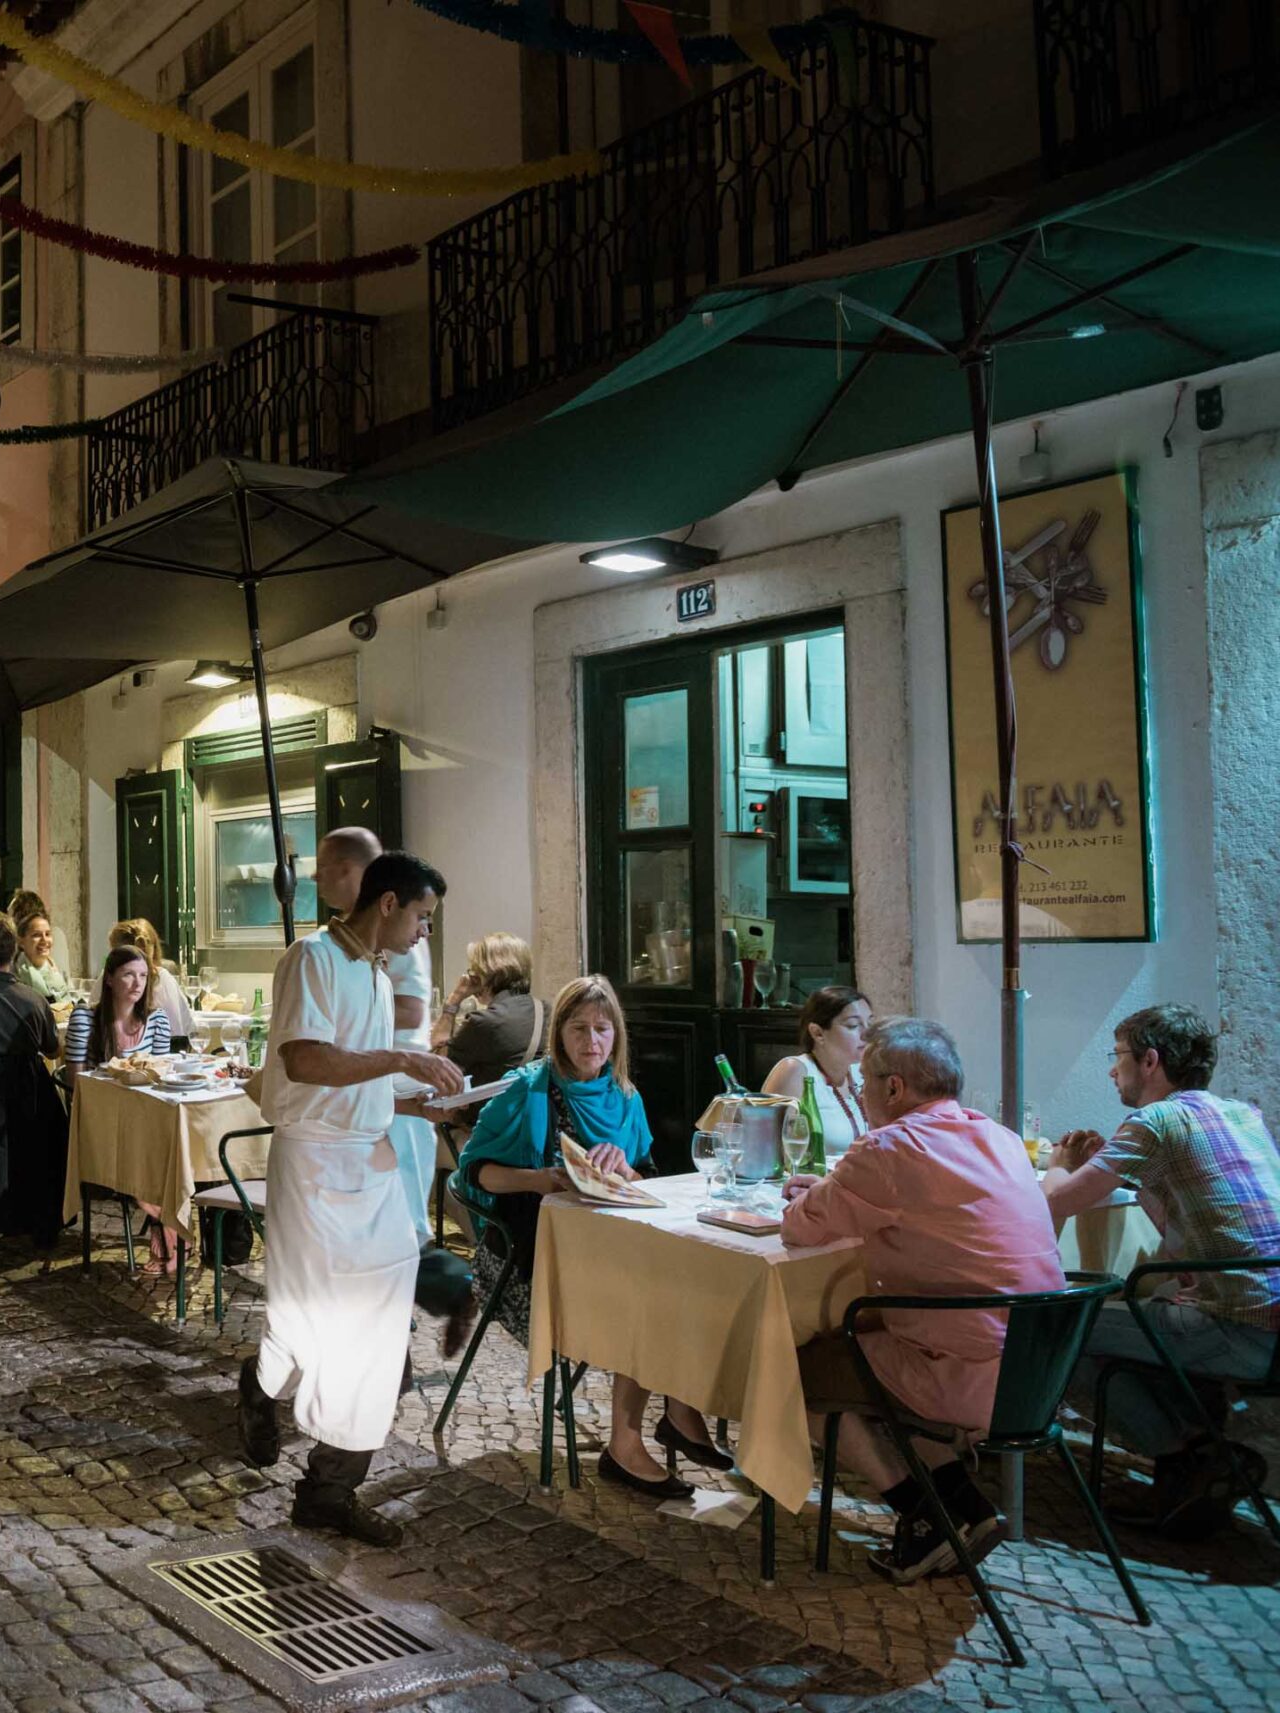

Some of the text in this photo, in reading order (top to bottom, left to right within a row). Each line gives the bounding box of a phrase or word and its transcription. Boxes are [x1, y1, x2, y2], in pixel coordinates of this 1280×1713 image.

[681, 587, 709, 616] 112
[973, 778, 1126, 838] AFAIA
[975, 834, 1126, 854] REAURANTE
